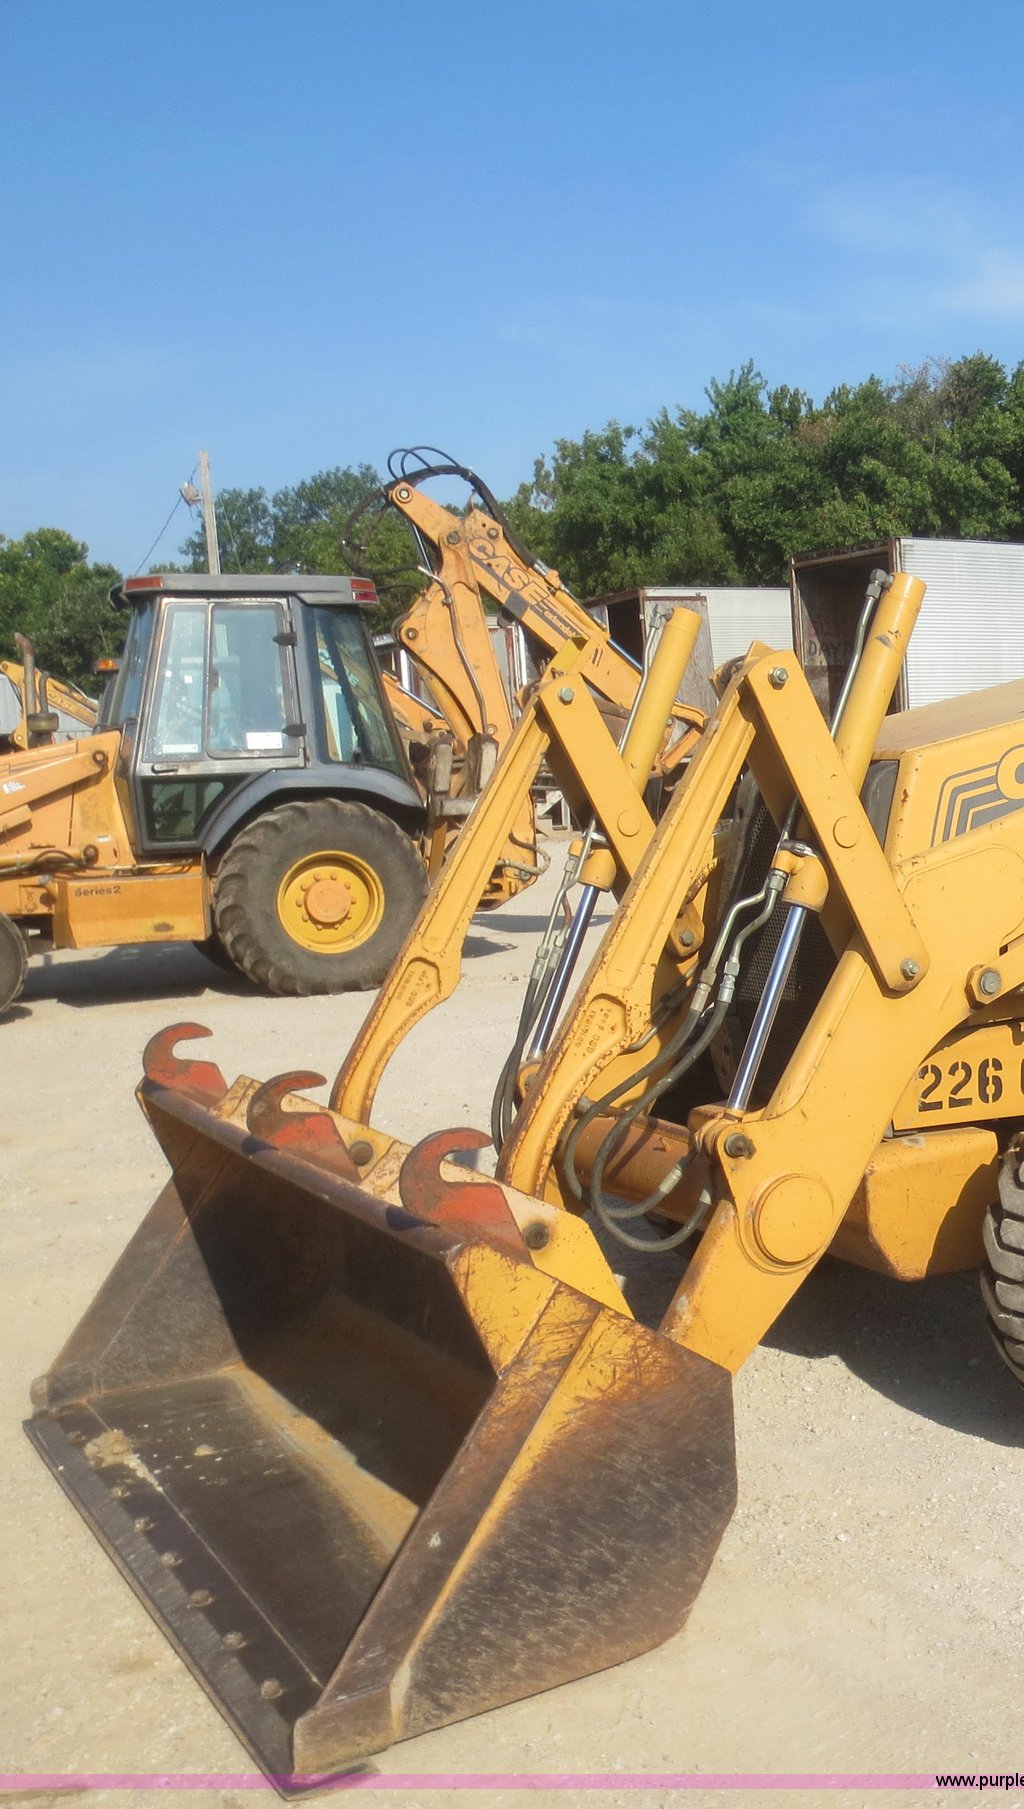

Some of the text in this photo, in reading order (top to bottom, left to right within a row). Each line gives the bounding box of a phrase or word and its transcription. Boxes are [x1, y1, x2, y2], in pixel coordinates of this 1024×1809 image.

[468, 538, 550, 606] CASE
[113, 885, 121, 894] 2
[918, 1057, 1003, 1112] 226
